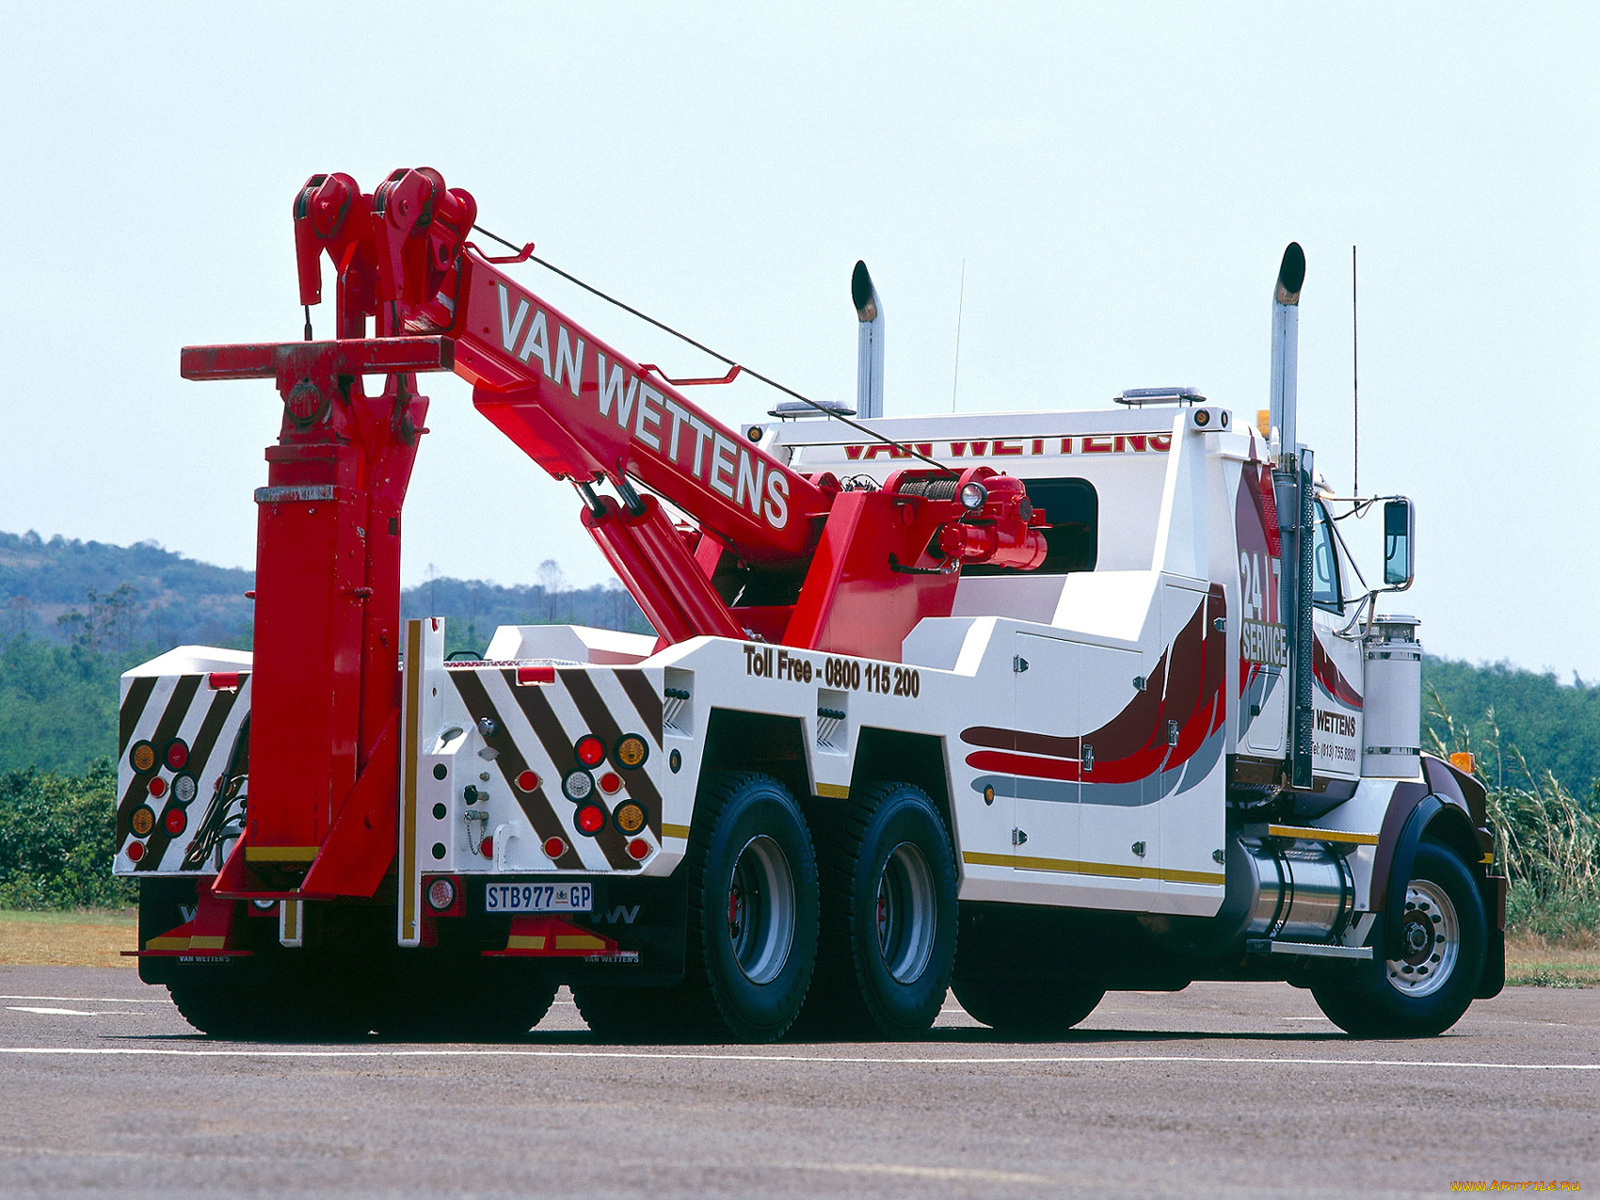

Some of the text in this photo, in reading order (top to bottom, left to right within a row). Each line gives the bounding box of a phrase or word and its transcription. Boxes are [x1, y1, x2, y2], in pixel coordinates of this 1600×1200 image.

[498, 282, 790, 530] VAN WETTENS
[1243, 621, 1287, 667] SERVICE
[743, 644, 773, 679] Toll
[777, 650, 812, 684] Free
[825, 657, 860, 691] 0800
[865, 663, 890, 695] 115
[893, 667, 920, 699] 200
[1316, 709, 1356, 738] WETTENS
[1334, 745, 1344, 760] 755
[488, 886, 591, 908] STB977 GP
[584, 955, 599, 963] VAN
